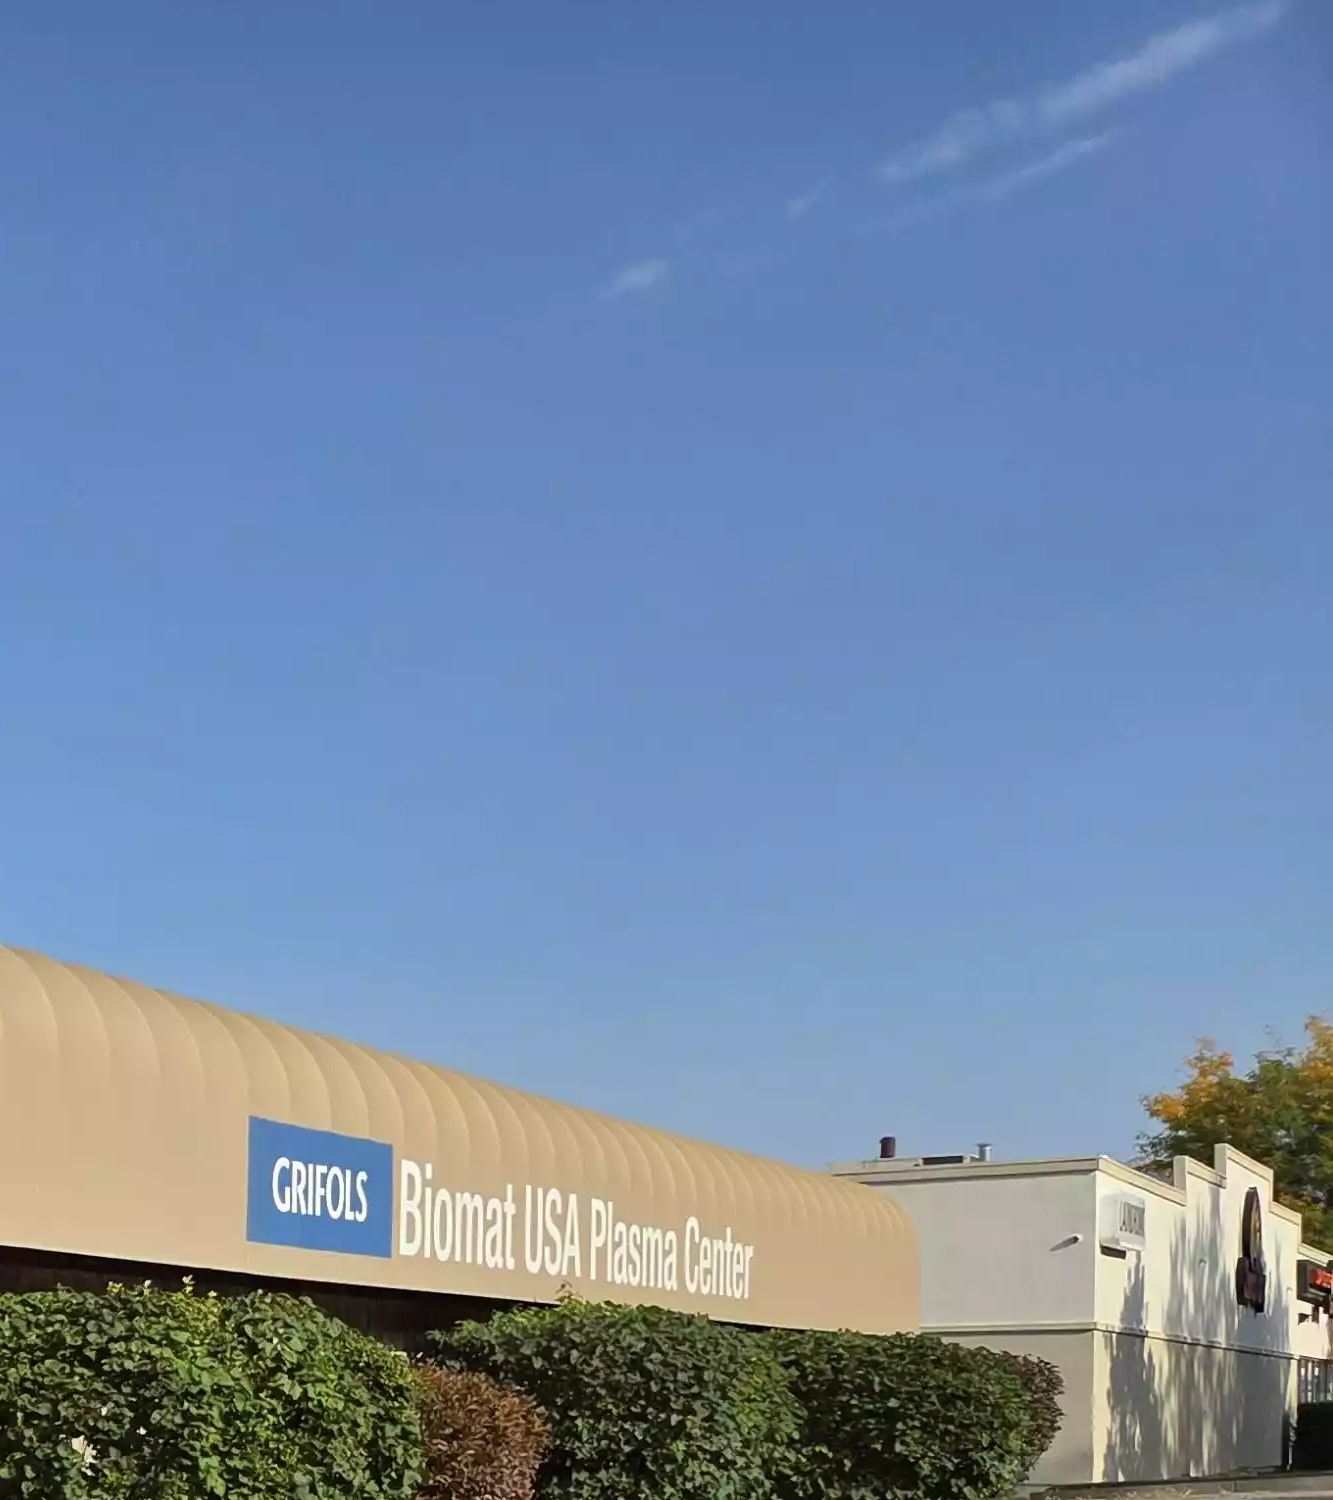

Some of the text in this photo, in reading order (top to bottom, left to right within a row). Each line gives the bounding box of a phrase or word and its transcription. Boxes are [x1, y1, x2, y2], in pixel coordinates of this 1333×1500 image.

[271, 1156, 754, 1300] GRIFOLS Biomat USA Plasma Center
